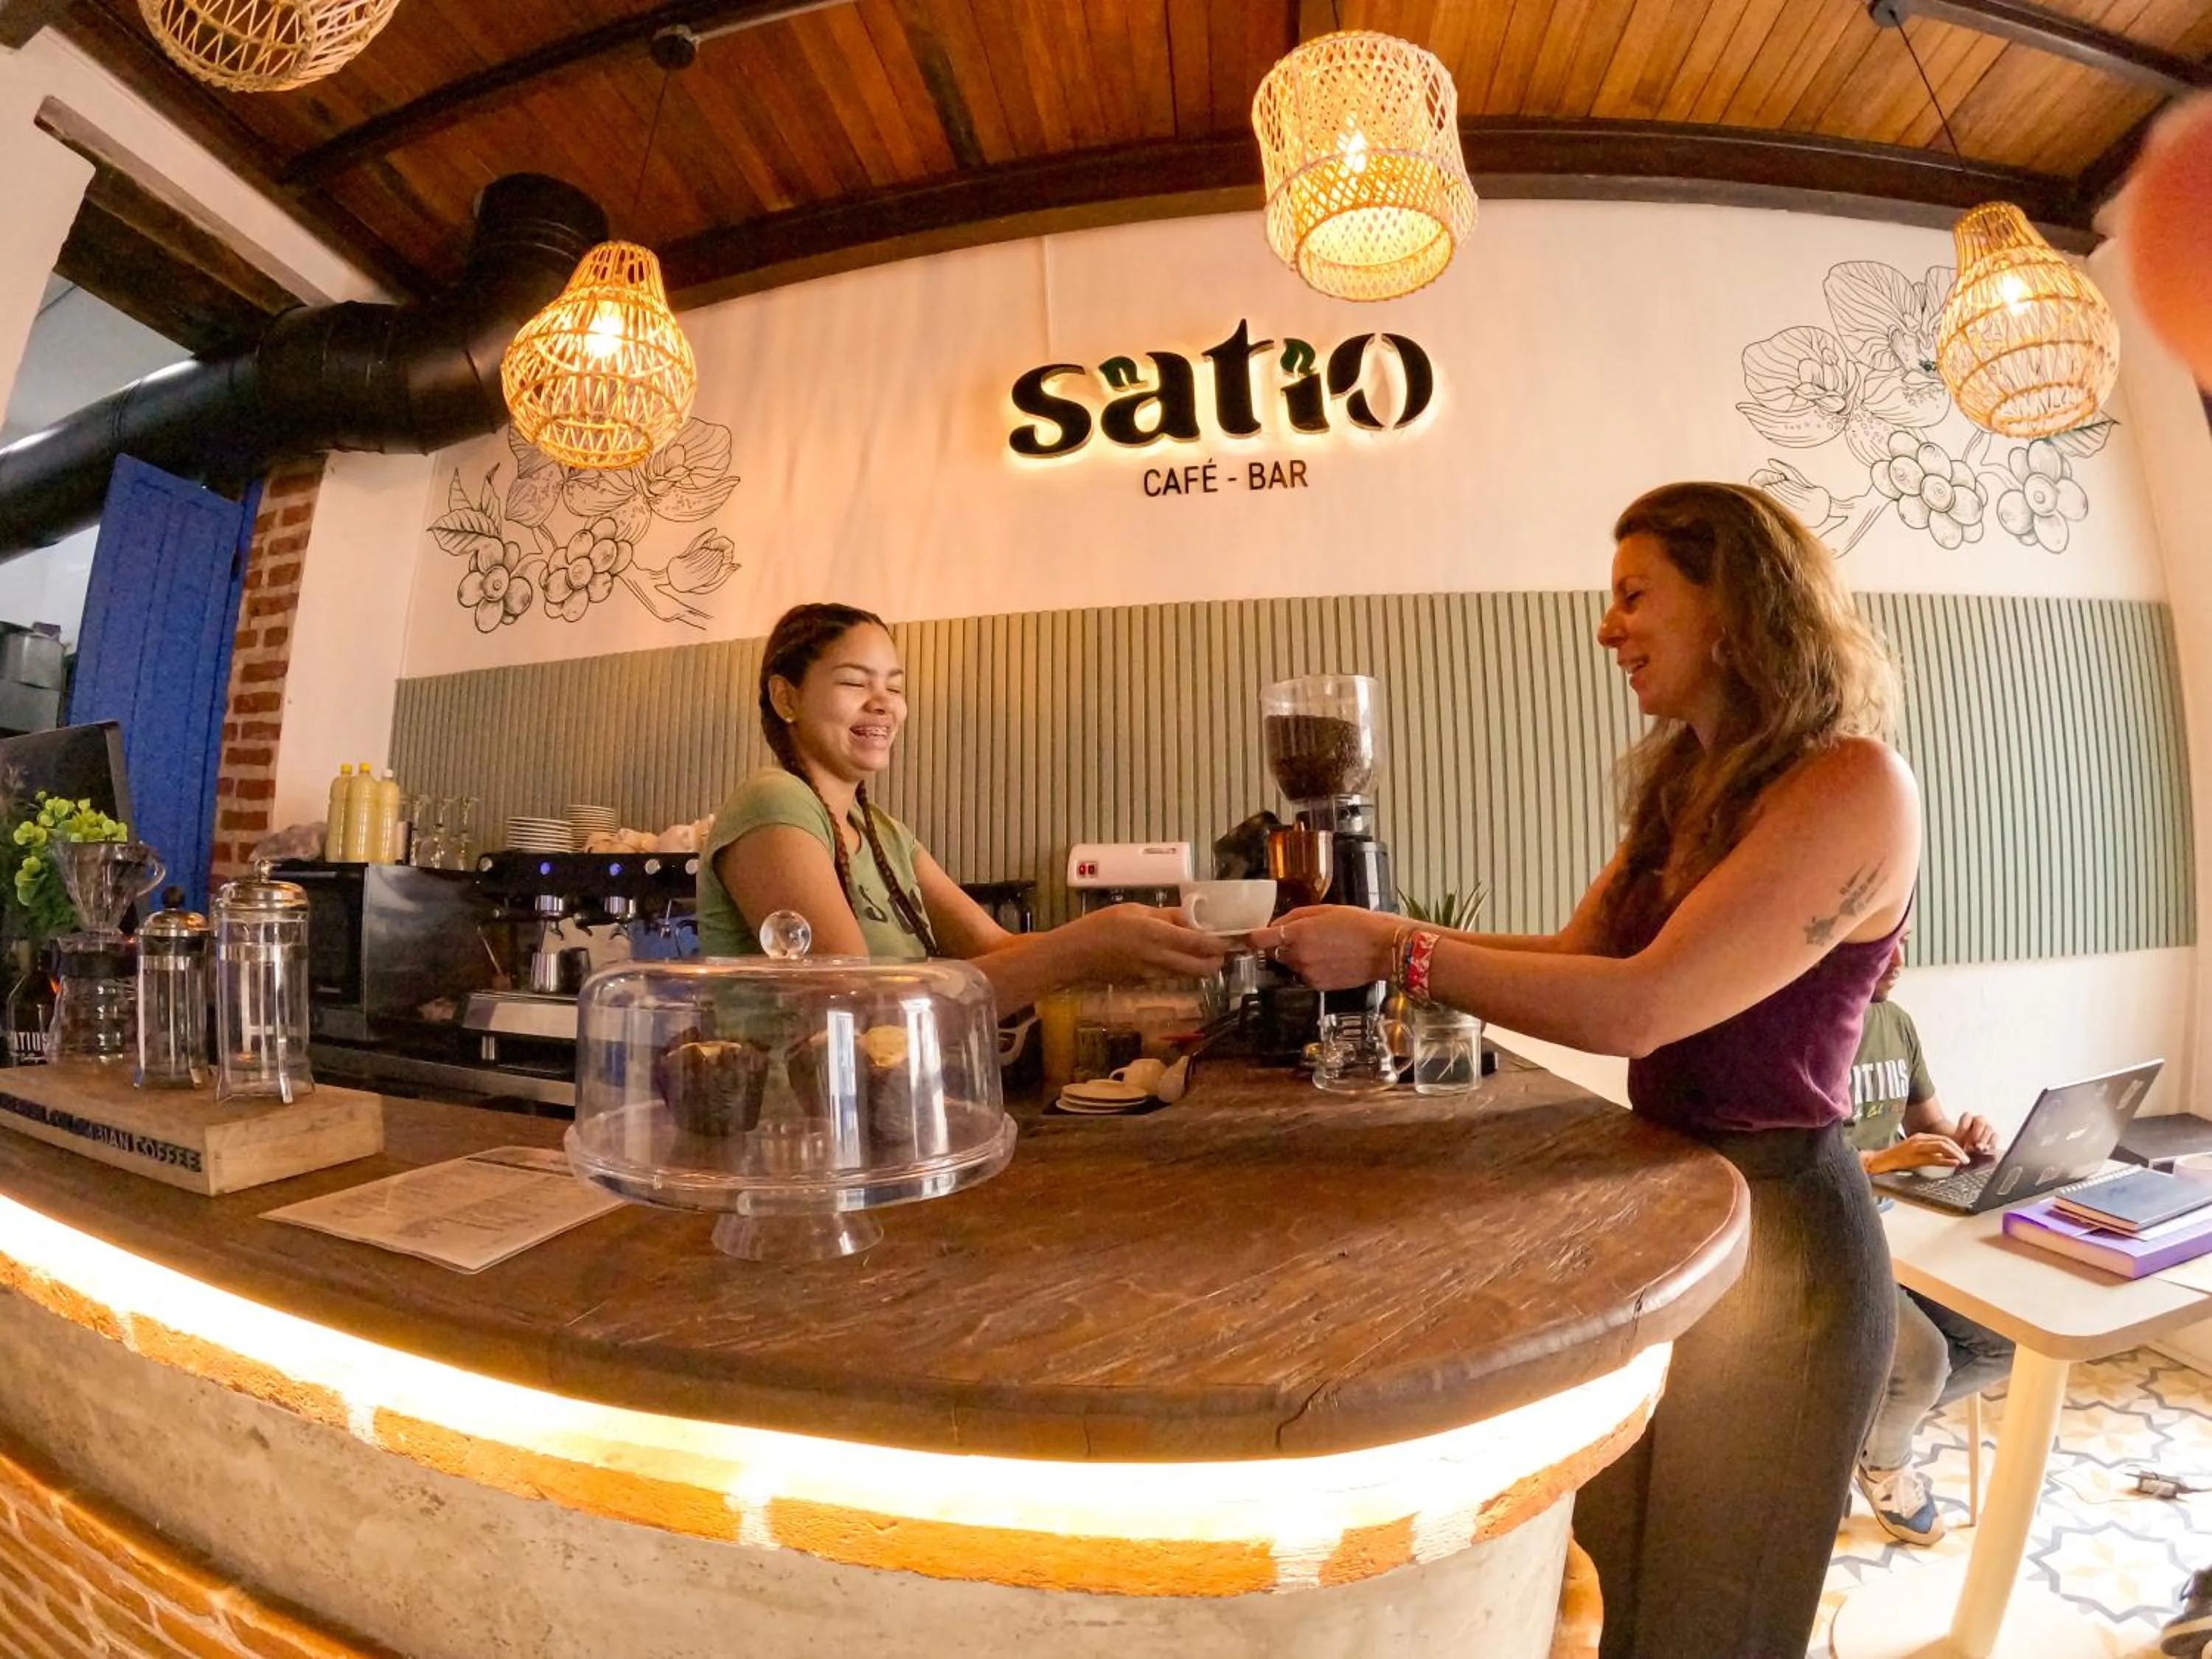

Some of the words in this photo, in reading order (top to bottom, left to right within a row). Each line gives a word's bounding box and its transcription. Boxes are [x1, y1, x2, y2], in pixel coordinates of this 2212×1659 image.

[1008, 318, 1434, 459] satio
[1144, 457, 1218, 497] CAFÉ
[1248, 459, 1308, 490] BAR
[136, 1134, 202, 1172] COFFEE
